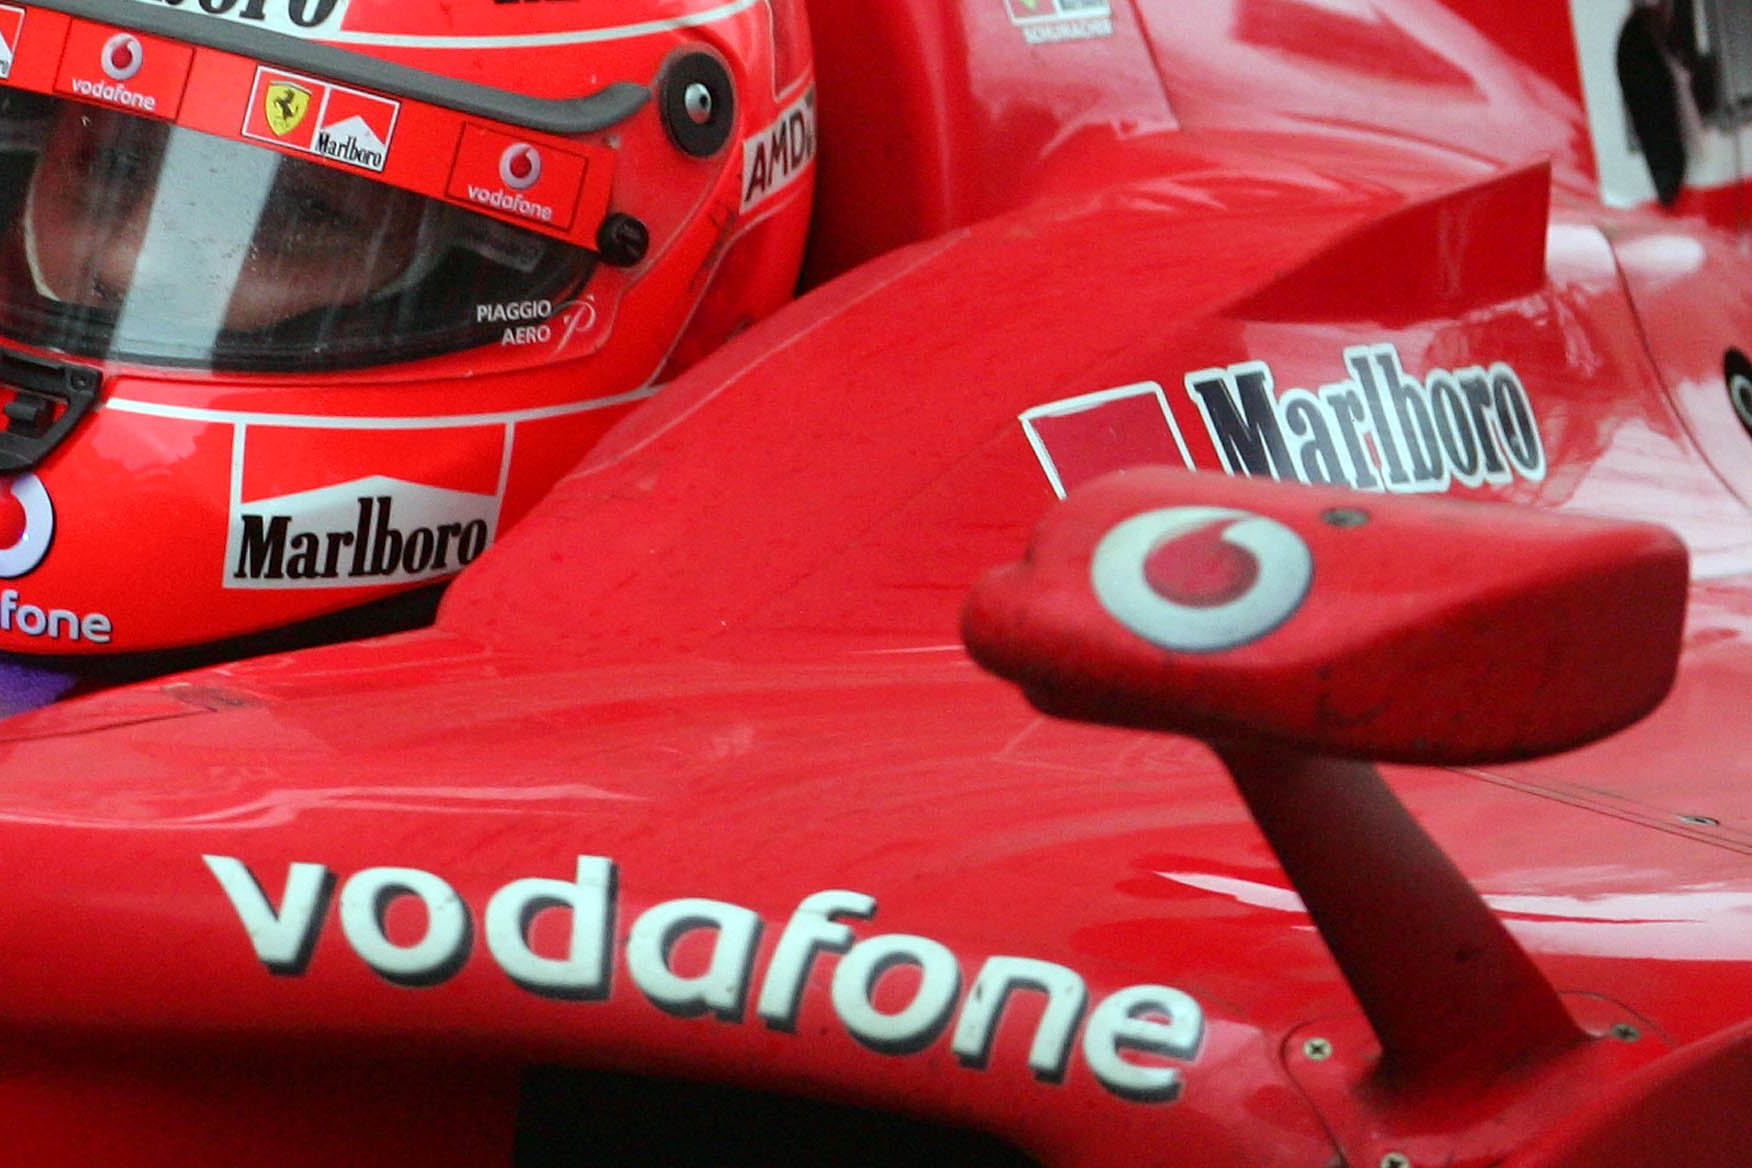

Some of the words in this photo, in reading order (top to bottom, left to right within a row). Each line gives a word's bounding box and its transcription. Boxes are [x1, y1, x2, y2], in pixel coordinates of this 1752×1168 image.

[71, 77, 157, 112] vodafone
[316, 131, 384, 169] Marlboro
[744, 110, 806, 203] AMD
[467, 182, 553, 222] vodafone
[476, 299, 553, 324] PIAGGIO
[500, 324, 552, 347] AERO
[1185, 343, 1547, 492] Marlboro
[232, 495, 489, 581] Marlboro
[202, 853, 1206, 1103] vodafone
